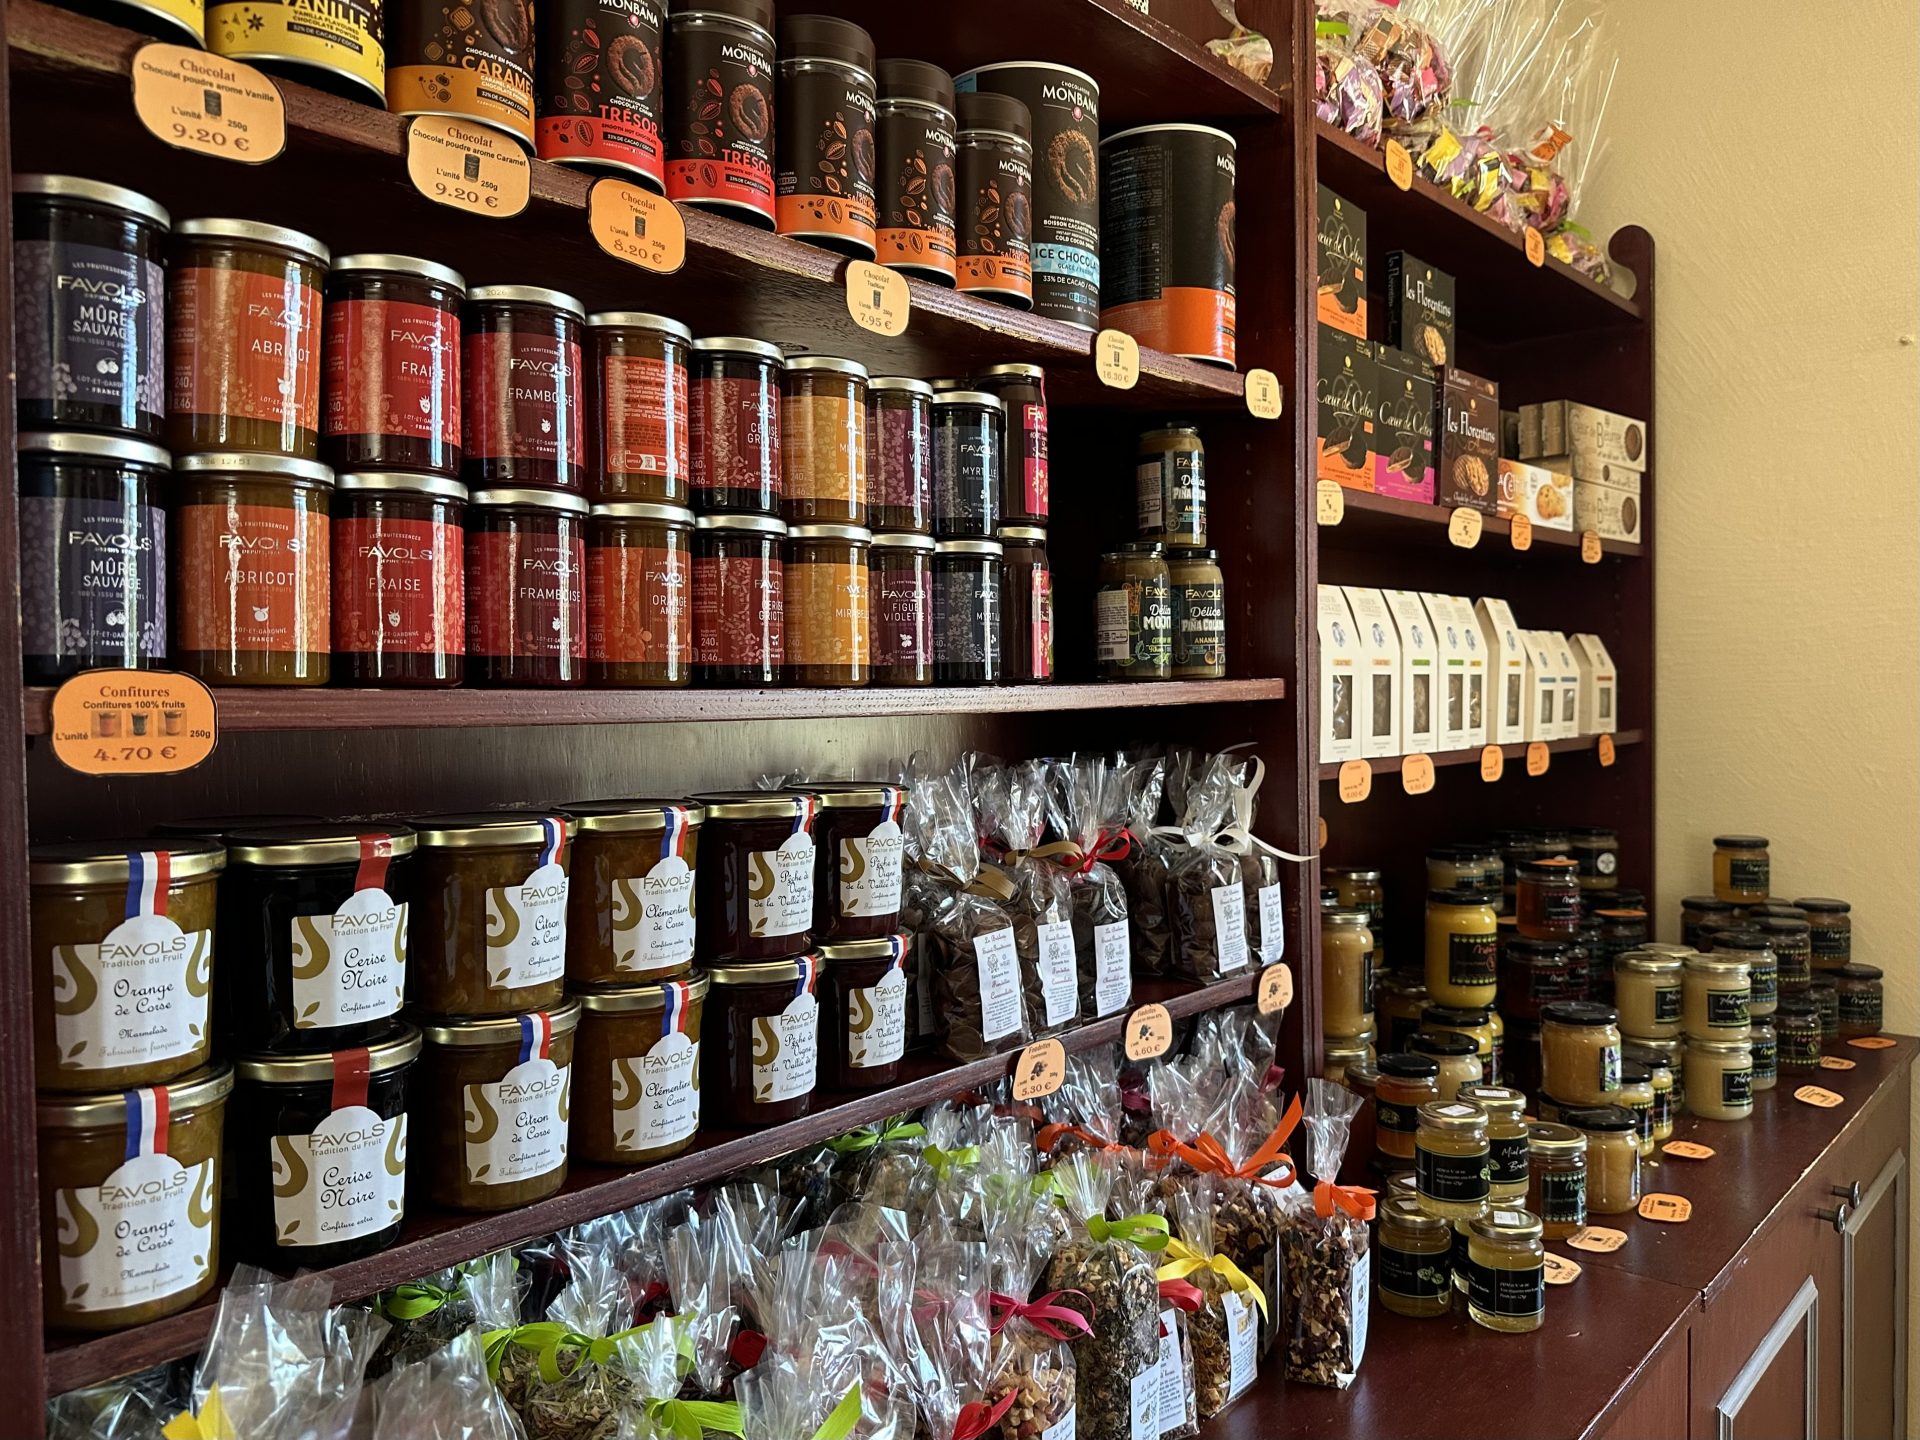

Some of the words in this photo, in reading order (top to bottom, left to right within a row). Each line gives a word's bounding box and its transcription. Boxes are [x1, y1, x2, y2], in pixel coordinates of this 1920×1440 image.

[283, 0, 369, 34] ANILLE
[600, 0, 659, 28] MONBANA
[465, 47, 498, 62] CHOCOLAT
[722, 44, 772, 77] MONBANA
[180, 59, 237, 82] Chocolat
[141, 62, 181, 81] Chocolat
[183, 75, 214, 91] poudre
[216, 82, 244, 96] arome
[245, 89, 276, 103] Vanille
[1042, 84, 1098, 119] MONBANA
[171, 106, 202, 120] L'unité
[599, 103, 659, 136] TRÉSOR
[228, 119, 248, 132] 250g
[172, 123, 227, 147] 9.20
[235, 137, 250, 153] €
[447, 126, 493, 149] Chocolat
[413, 128, 445, 147] Chocolat
[446, 139, 471, 154] poudre
[472, 147, 495, 158] arome
[496, 152, 527, 169] Caramel
[721, 148, 772, 178] TRÉSOR
[436, 167, 461, 182] L'unité
[481, 179, 498, 193] 250g
[435, 182, 479, 204] 9.20
[485, 196, 498, 209] €
[621, 191, 657, 212] Chocolat
[629, 204, 649, 217] Trésor
[652, 252, 663, 265] €
[1034, 245, 1054, 260] ICE
[1042, 274, 1055, 283] 33%
[1056, 276, 1065, 286] DE
[1066, 279, 1085, 293] CACAO
[860, 313, 882, 328] 7.95
[884, 320, 893, 330] €
[510, 357, 572, 378] FAVOLS
[1460, 410, 1496, 444] Florentins
[69, 531, 152, 551] FAVOLS
[358, 546, 434, 562] FAVOLS
[90, 557, 138, 575] MÛRE
[524, 558, 580, 576] FAVOLS
[83, 574, 142, 592] SAUVAGE
[224, 569, 296, 587] ABRICOT
[369, 577, 421, 593] FRAISE
[1190, 606, 1221, 619] Délice
[248, 635, 275, 643] FRANCE
[100, 685, 170, 698] Confitures
[83, 701, 132, 711] Confitures
[135, 701, 160, 710] 100%
[162, 701, 186, 709] fruits
[56, 732, 88, 742] L'unité
[190, 730, 211, 740] 250g
[94, 746, 153, 762] 4.70
[160, 746, 177, 760] €
[866, 835, 903, 850] FAVOLS
[775, 846, 814, 863] FAVOLS
[643, 873, 692, 891] FAVOLS
[520, 881, 567, 902] FAVOLS
[645, 887, 672, 897] Tradition
[331, 907, 396, 930] FAVOLS
[535, 915, 561, 933] Citron
[665, 919, 685, 930] Corse
[333, 927, 369, 938] Tradition
[98, 936, 187, 960] FAVOLS
[531, 936, 541, 948] de
[101, 956, 146, 969] Tradition
[148, 954, 160, 965] du
[163, 952, 183, 964] Fruit
[344, 947, 388, 970] Cerise
[113, 978, 175, 1001] Orange
[341, 970, 388, 992] Noire
[874, 979, 906, 998] FAVOLS
[114, 1004, 130, 1017] de
[135, 996, 173, 1015] Corse
[780, 1004, 818, 1027] FAVOLS
[118, 1026, 168, 1040] Marmelade
[642, 1045, 694, 1070] FAVOLS
[1134, 1045, 1153, 1059] 4.60
[645, 1066, 673, 1077] Tradition
[499, 1073, 561, 1099] FAVOLS
[1021, 1083, 1043, 1098] 5.30
[1044, 1081, 1053, 1092] €
[501, 1093, 534, 1106] Tradition
[653, 1100, 664, 1112] de
[666, 1094, 687, 1108] Corse
[515, 1111, 550, 1130] Citron
[307, 1122, 386, 1149] FAVOLS
[511, 1132, 523, 1145] de
[526, 1127, 552, 1143] Corse
[310, 1146, 350, 1159] Tradition
[351, 1143, 363, 1154] du
[363, 1137, 383, 1150] Fruit
[322, 1166, 374, 1188] Cerise
[98, 1170, 189, 1203] FAVOLS
[102, 1196, 146, 1211] Tradition
[148, 1194, 162, 1205] du
[164, 1187, 185, 1201] Fruit
[320, 1188, 376, 1211] Noire
[114, 1218, 177, 1243] Orange
[320, 1220, 355, 1237] Confiture
[115, 1245, 131, 1259] de
[136, 1235, 175, 1254] Corse
